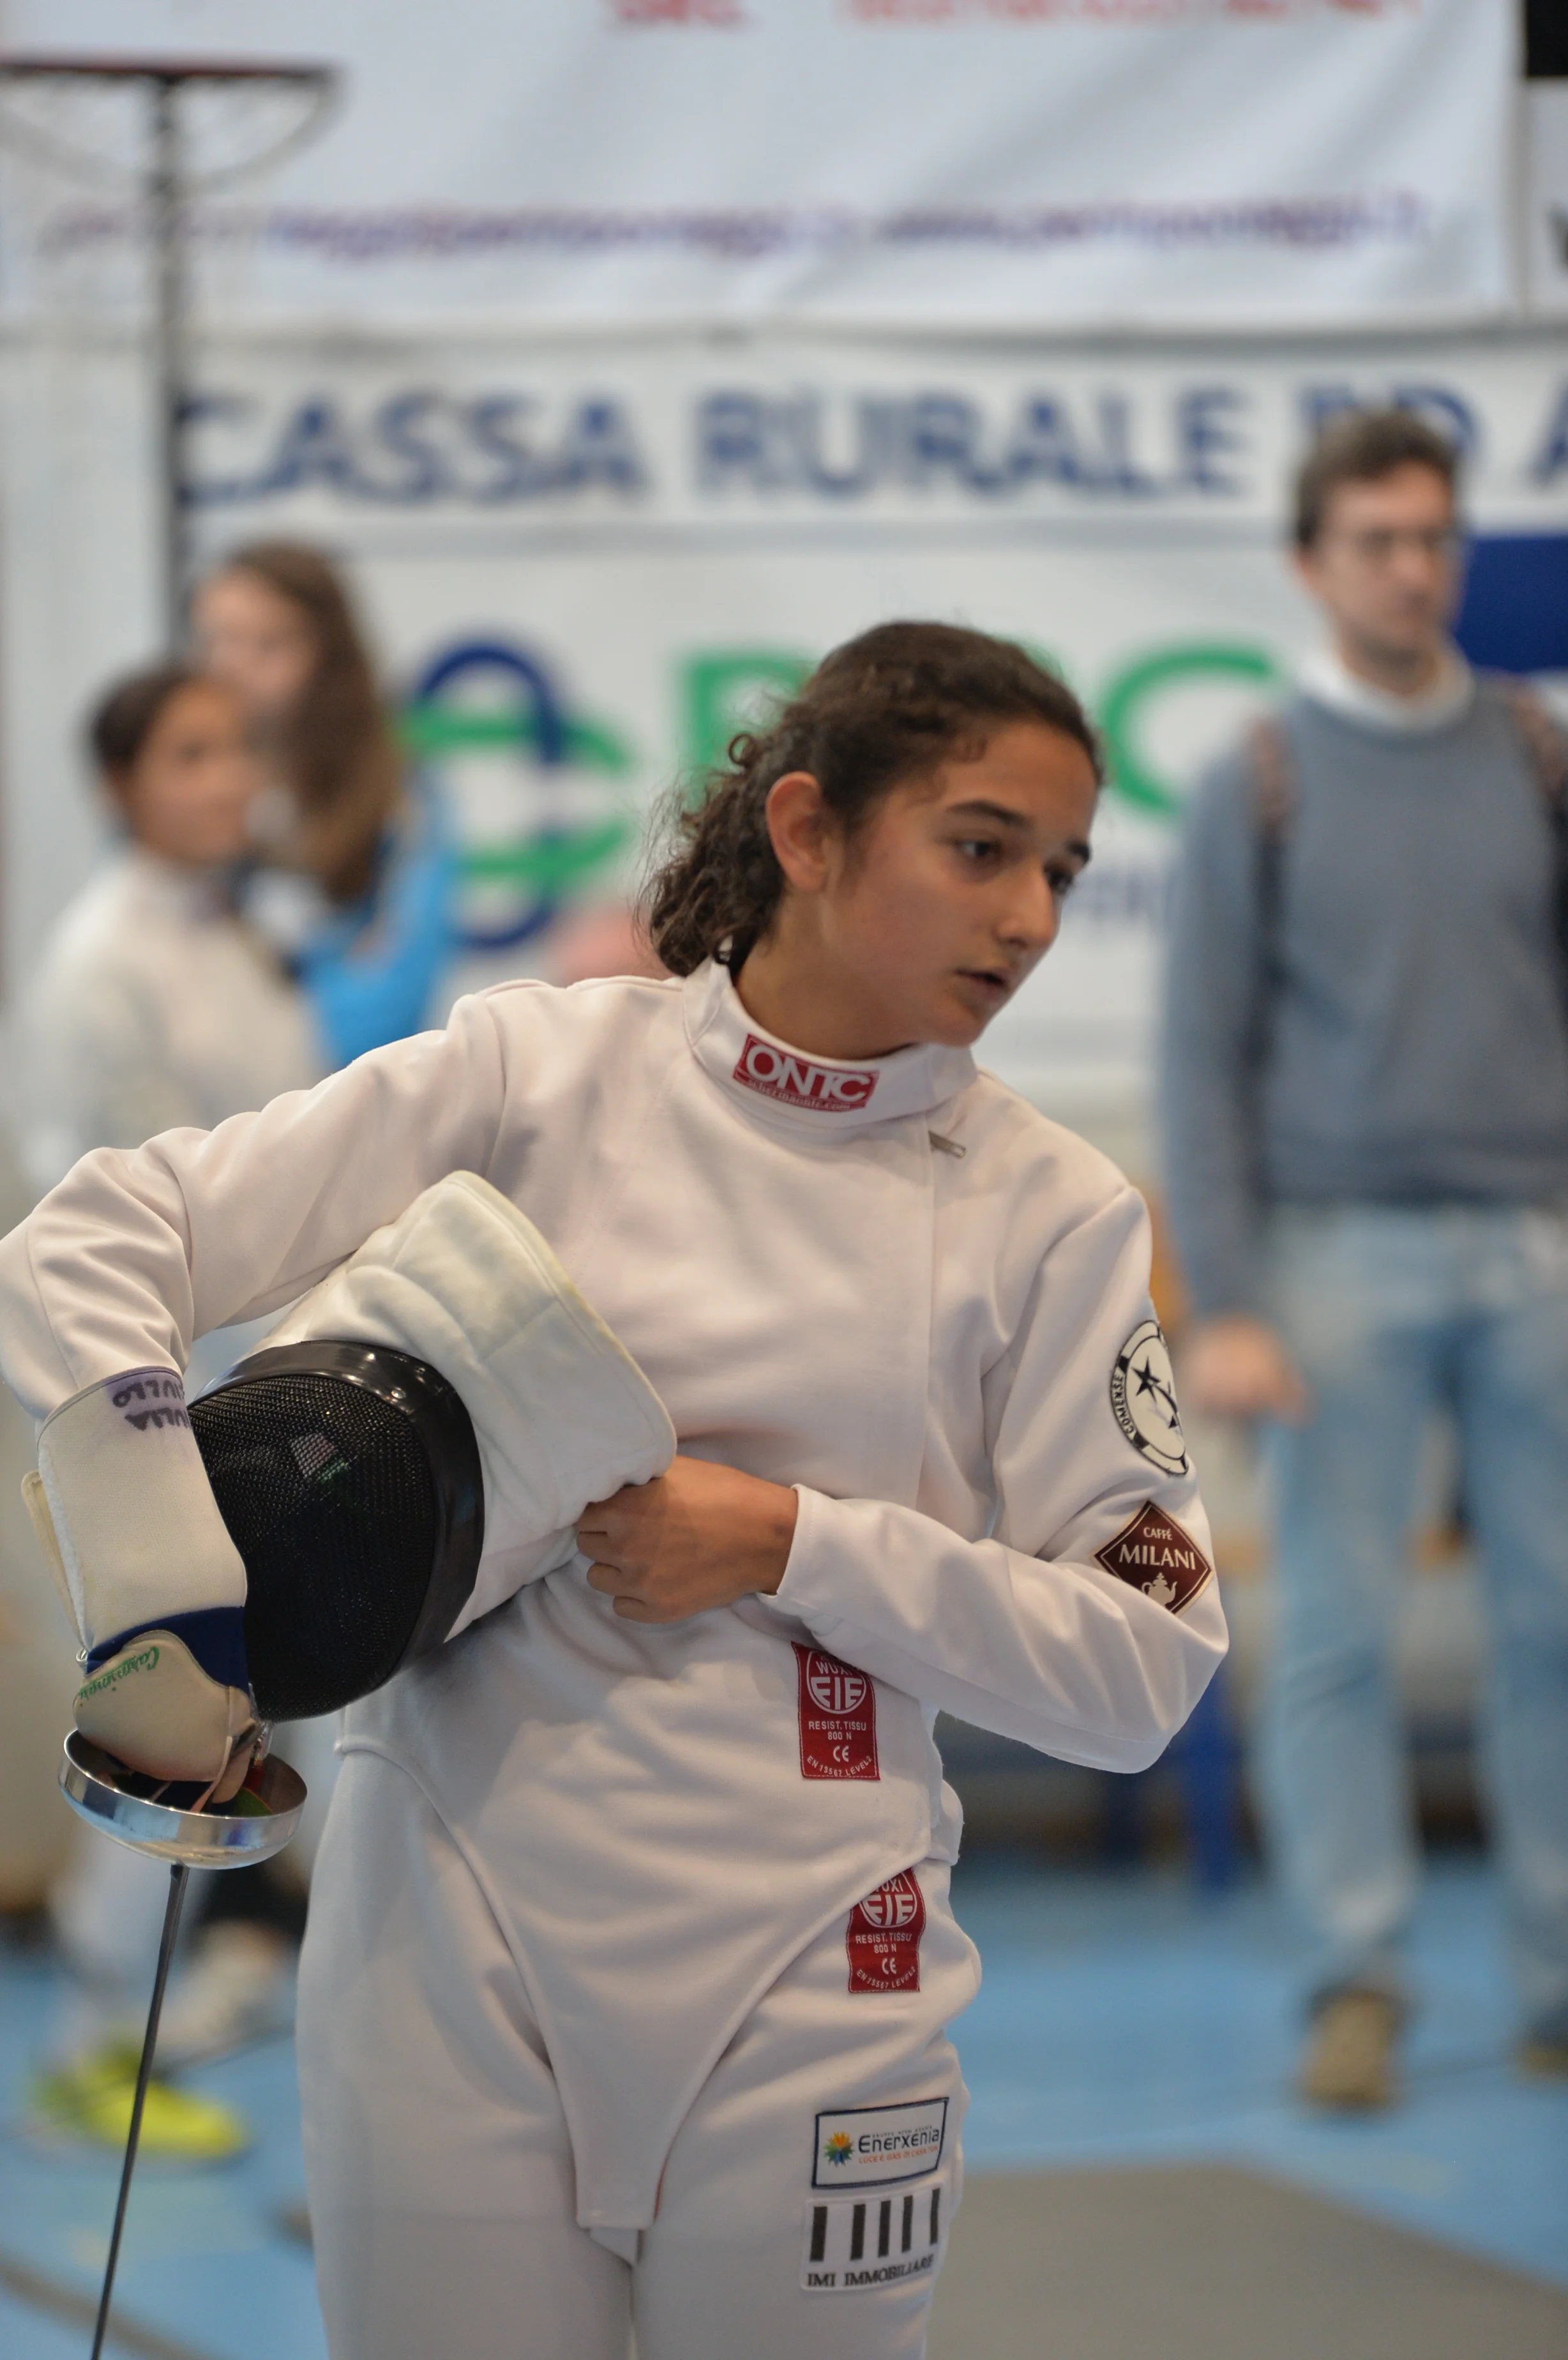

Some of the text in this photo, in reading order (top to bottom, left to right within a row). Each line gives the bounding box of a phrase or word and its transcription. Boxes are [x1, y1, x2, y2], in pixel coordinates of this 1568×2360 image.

[176, 391, 646, 506] CASSA
[697, 386, 1245, 503] RURALE
[1113, 1375, 1134, 1434] COMENSE
[1143, 1526, 1172, 1540] CAFFÉ
[1119, 1544, 1196, 1570] MILANI
[809, 1721, 866, 1731] RESIST. TISSU
[827, 1732, 852, 1740] 800 N
[807, 1755, 818, 1768] EN
[876, 1879, 903, 1892] UXI
[856, 1933, 912, 1944] RESIST. TISSU
[874, 1944, 896, 1953] 800 N
[857, 1969, 867, 1981] EN
[858, 2129, 939, 2153] Enerxenia
[807, 2254, 934, 2287] IMI IMMOBILIARE
